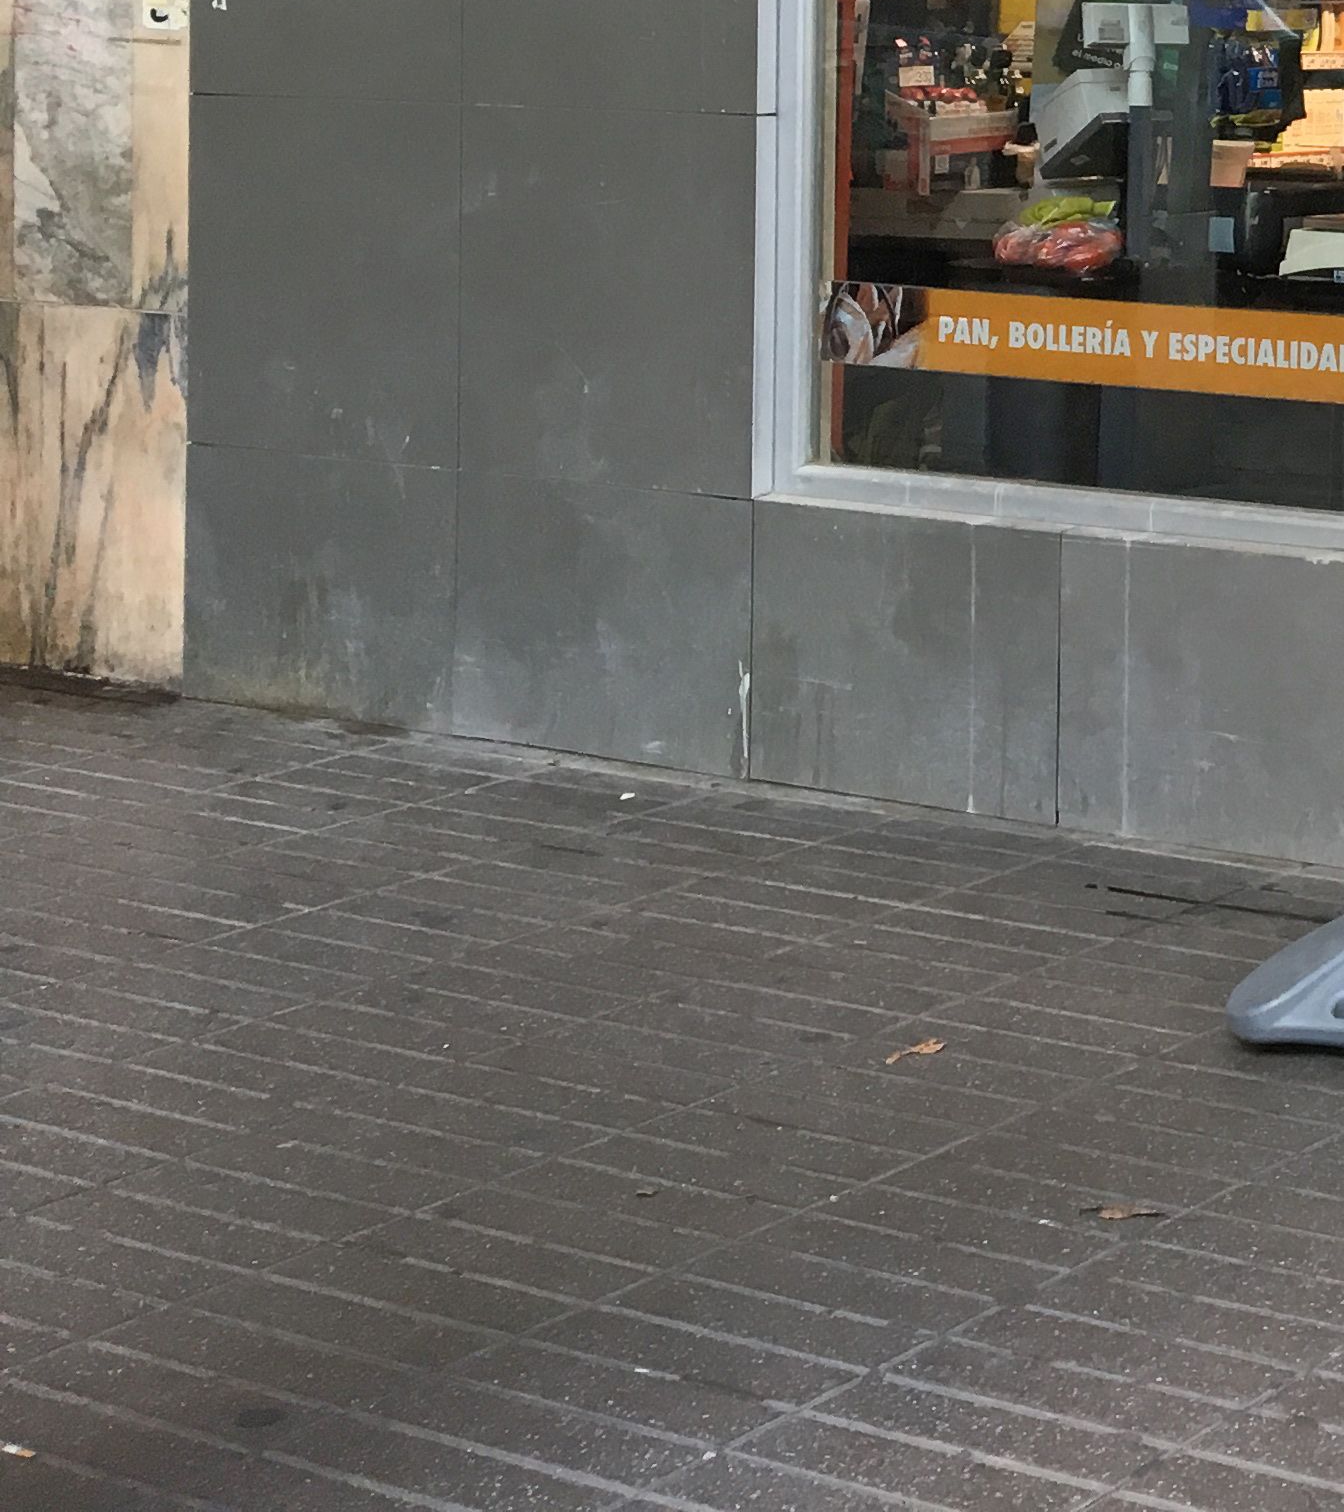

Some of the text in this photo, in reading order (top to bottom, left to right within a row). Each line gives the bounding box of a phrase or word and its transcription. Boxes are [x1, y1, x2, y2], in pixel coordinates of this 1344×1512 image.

[938, 316, 999, 350] PAN,
[1008, 321, 1130, 357] BOLLERÍA
[1141, 331, 1160, 359] Y
